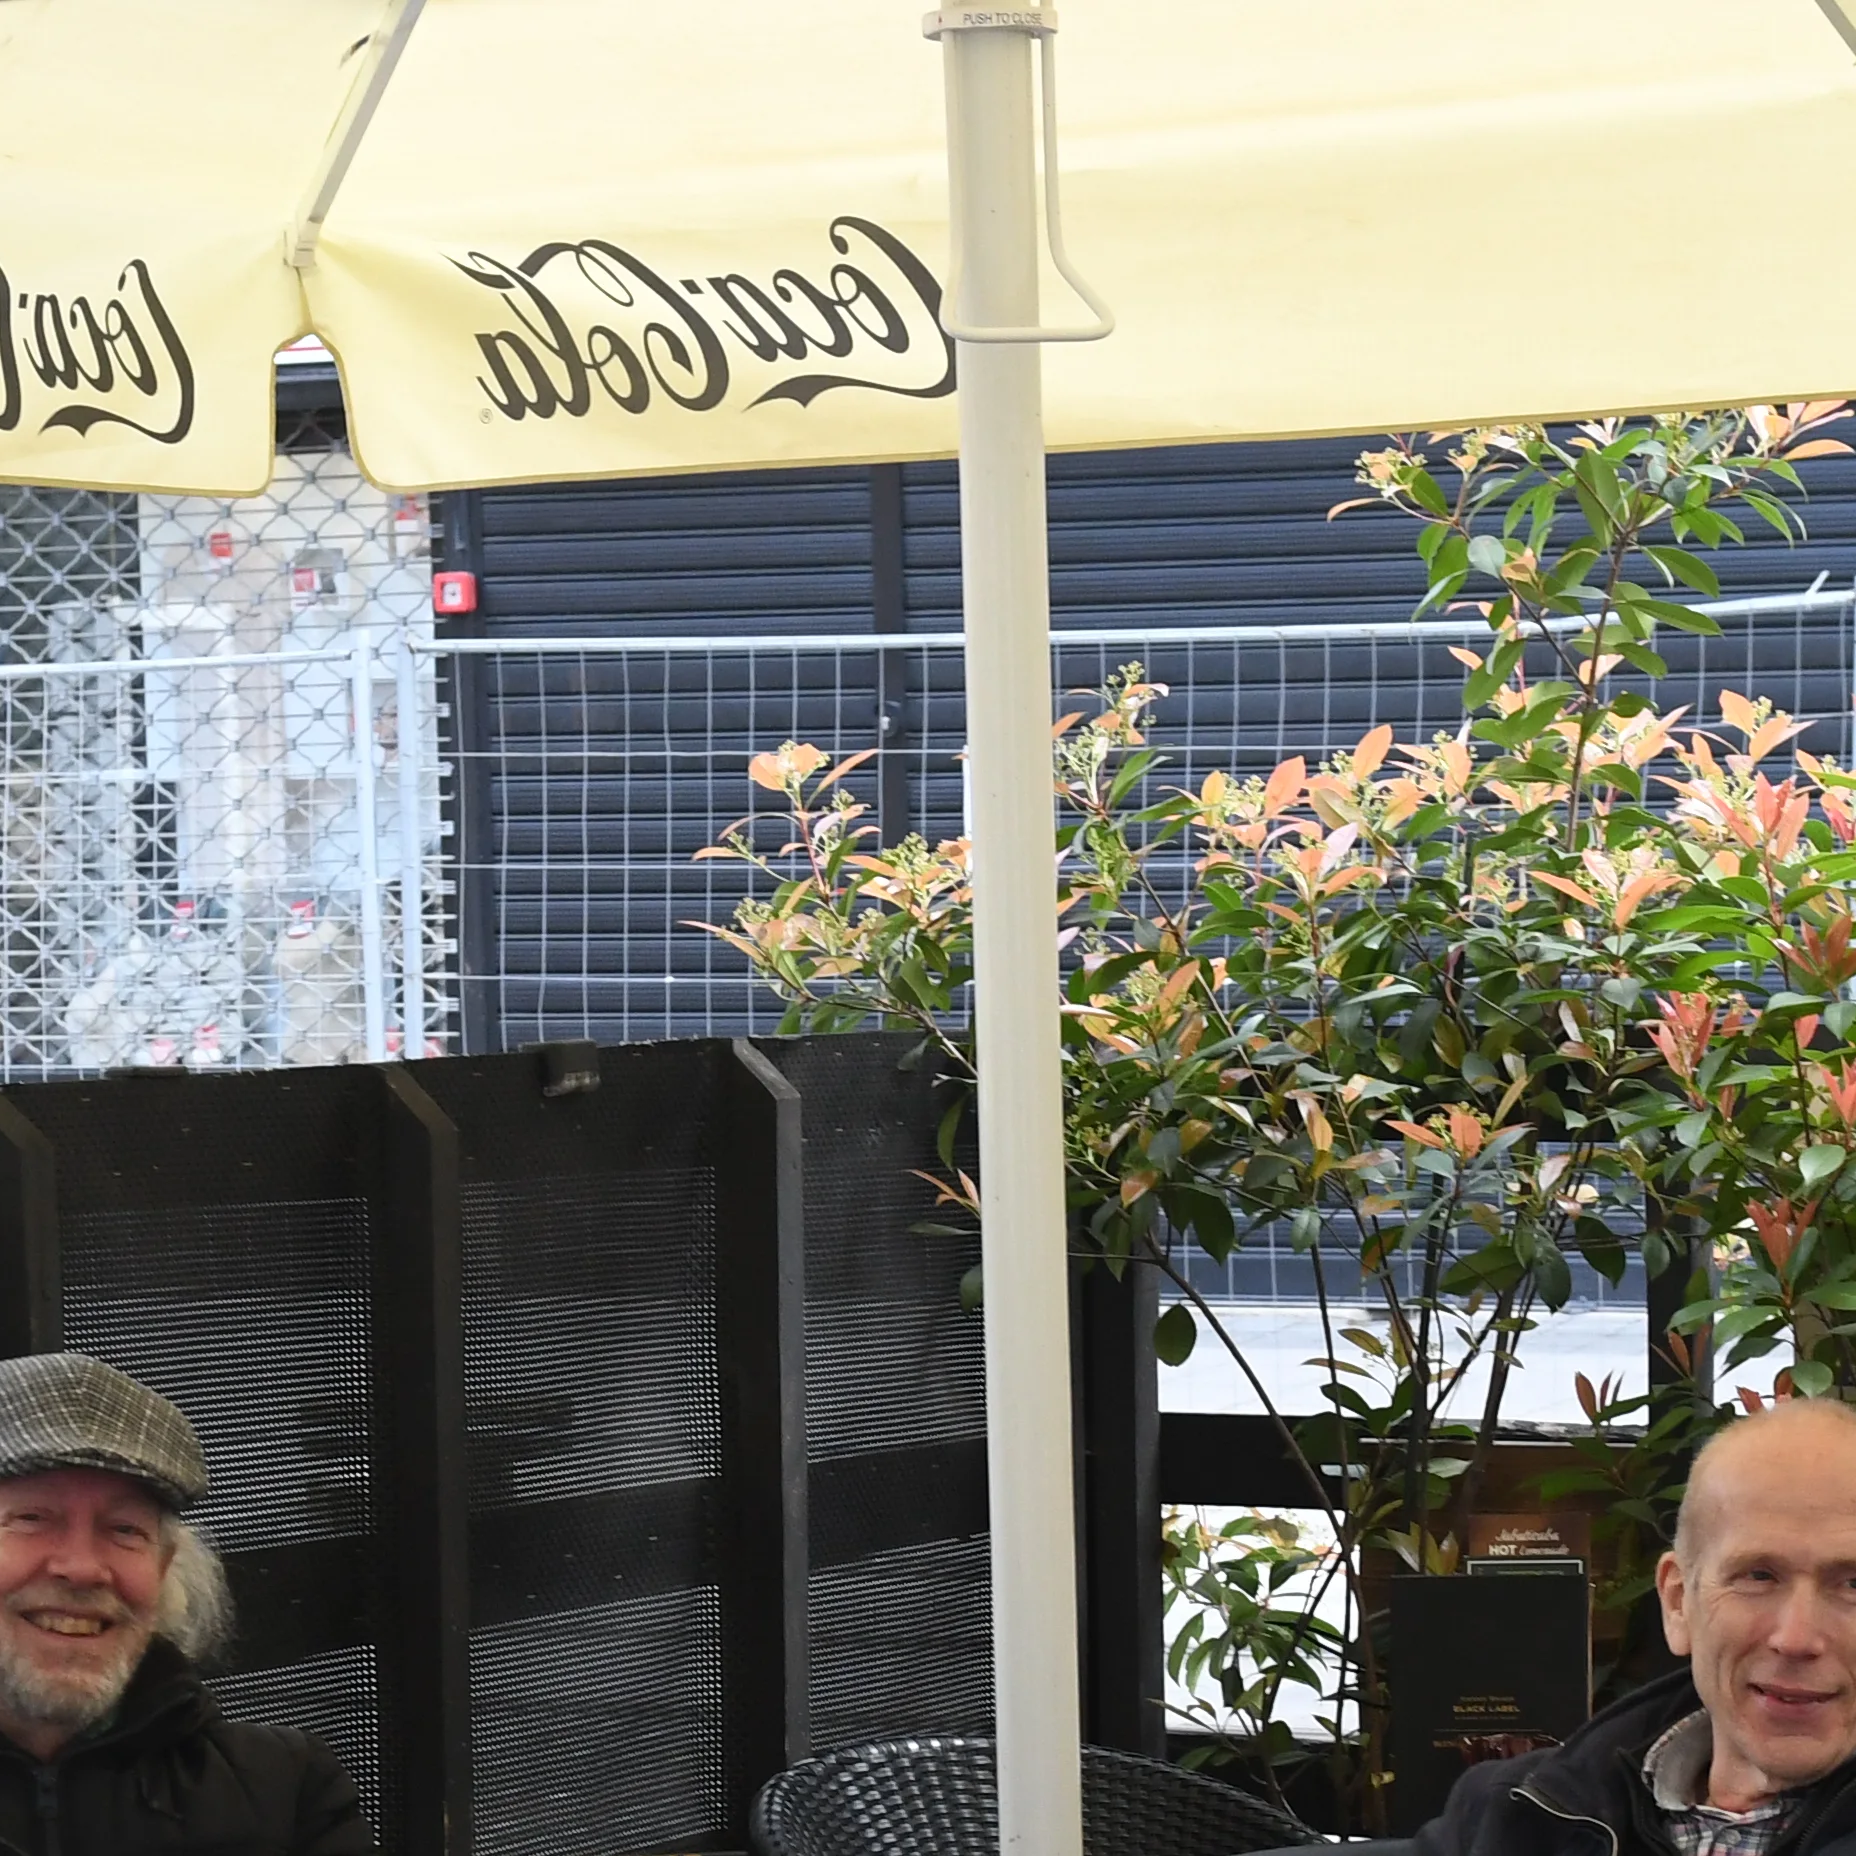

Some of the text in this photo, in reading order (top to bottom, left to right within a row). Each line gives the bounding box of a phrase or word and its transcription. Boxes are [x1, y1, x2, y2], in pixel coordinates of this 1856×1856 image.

[963, 13, 1043, 25] PUSH TO CLOSE
[1488, 1544, 1518, 1556] HOT
